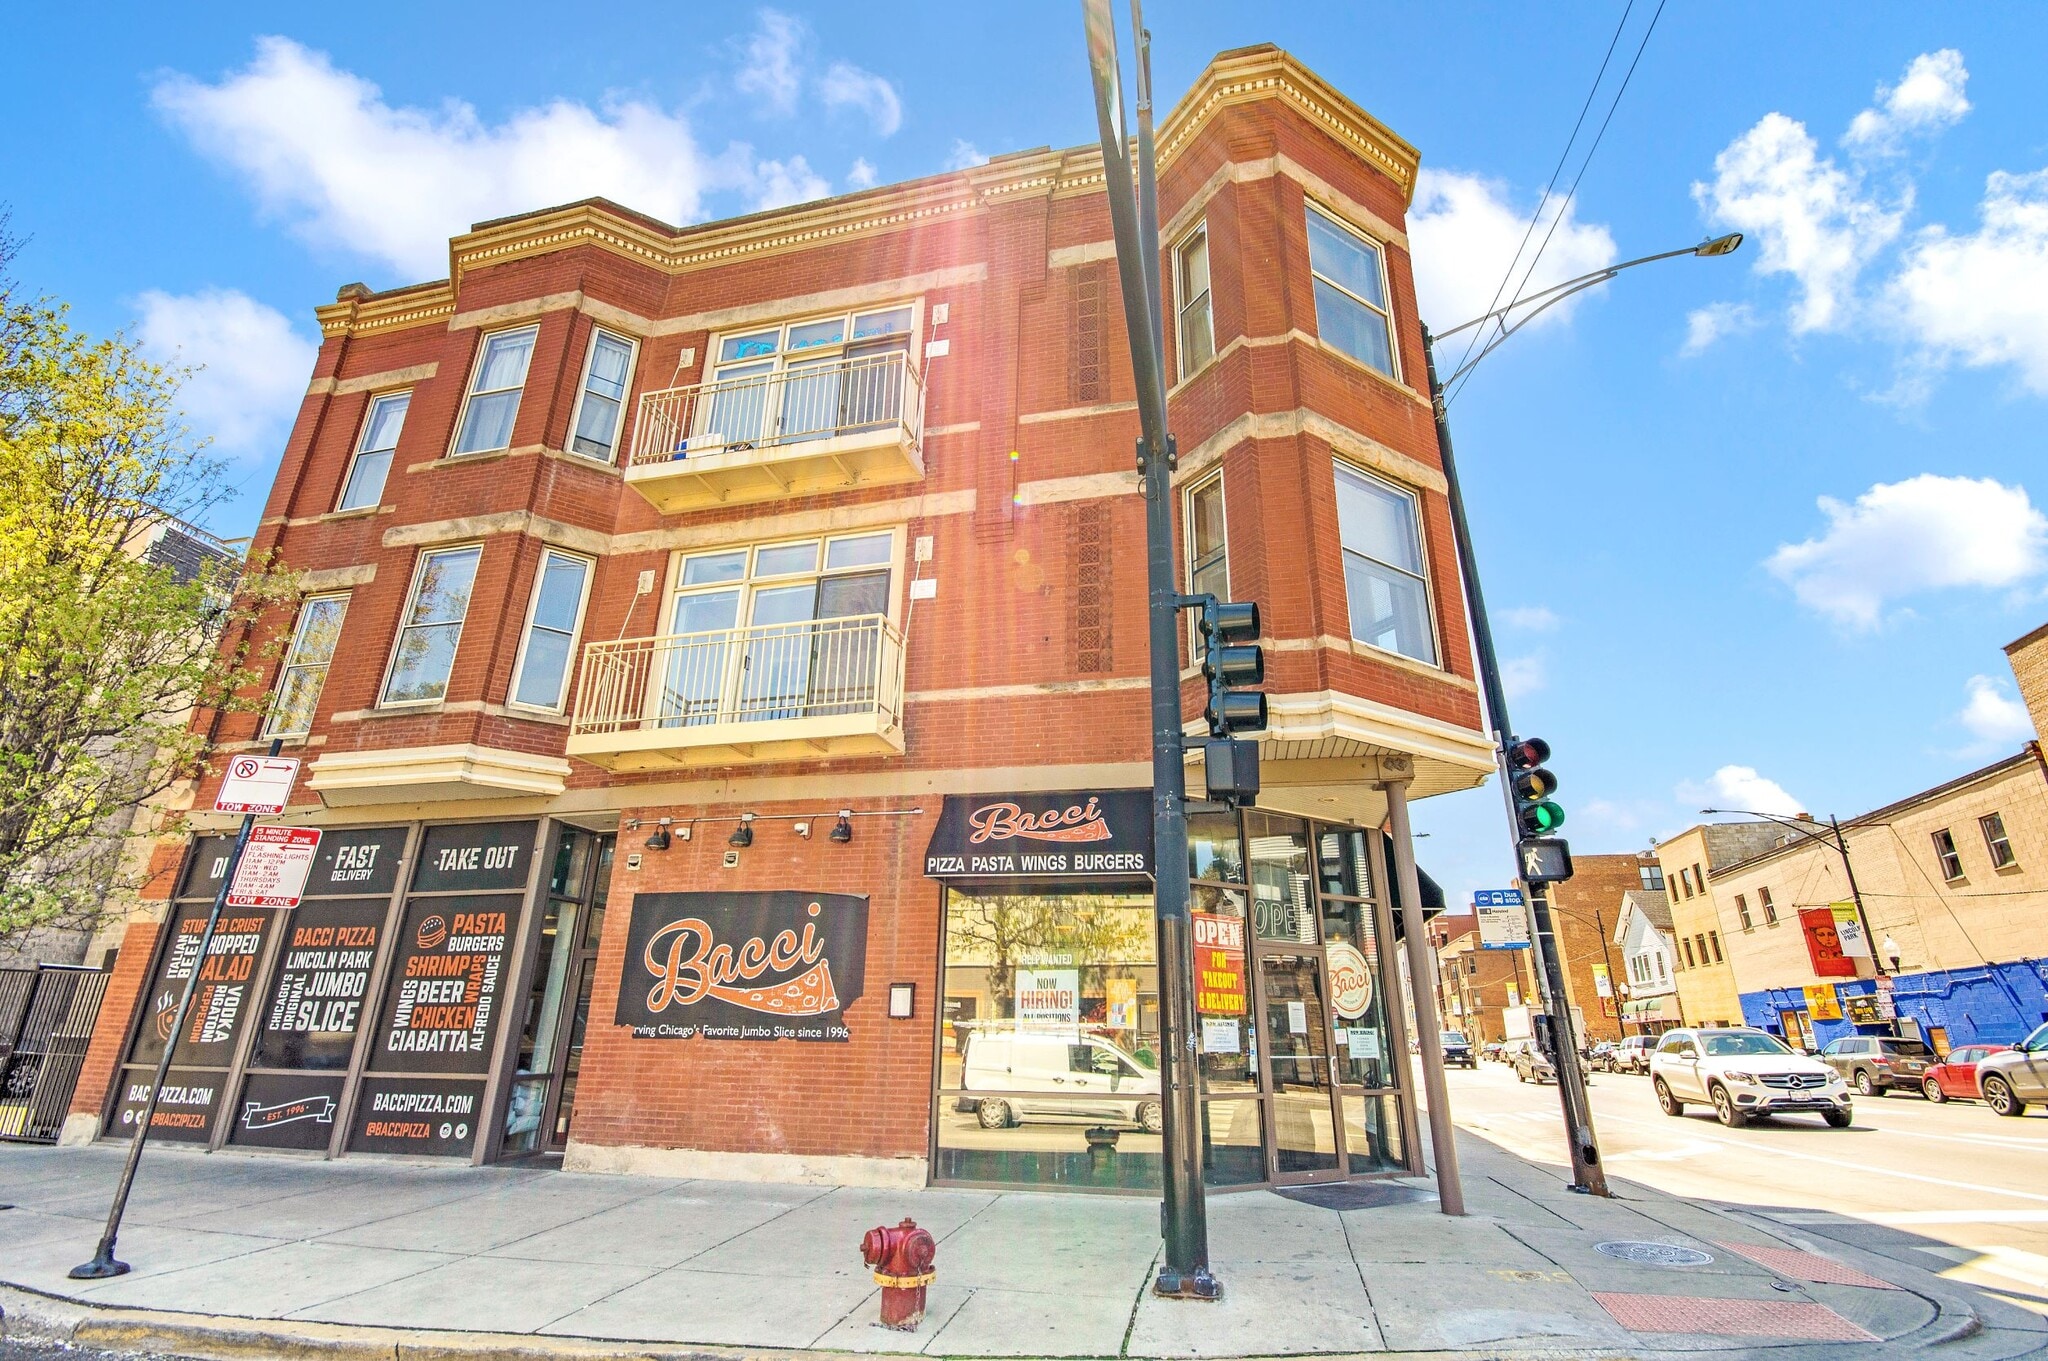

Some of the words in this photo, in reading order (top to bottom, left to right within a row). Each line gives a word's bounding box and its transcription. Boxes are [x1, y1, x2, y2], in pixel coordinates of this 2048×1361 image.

[220, 802, 243, 811] TOW
[248, 805, 278, 813] ZONE
[968, 796, 1102, 844] Bacci
[254, 835, 290, 843] STANDING
[284, 853, 310, 861] LIGHTS
[334, 844, 380, 869] FAST
[438, 847, 482, 871] TAKE
[484, 845, 519, 869] OUT
[927, 857, 965, 872] PIZZA
[971, 855, 1014, 871] PASTA
[1021, 854, 1067, 870] WINGS
[1074, 853, 1144, 870] BURGERS
[331, 869, 374, 881] DELIVERY
[232, 896, 257, 905] TOW
[264, 897, 294, 906] ZONE
[181, 918, 228, 933] STUFED
[229, 917, 265, 932] CRUST
[451, 912, 506, 935] PASTA
[1254, 900, 1312, 937] OPE
[293, 927, 335, 946] BACCI
[335, 926, 376, 946] PIZZA
[1195, 920, 1241, 946] OPEN
[1840, 925, 1861, 936] LINCOLN
[1844, 933, 1859, 941] PARK
[206, 934, 260, 954] HOPPED
[447, 935, 505, 952] BURGERS
[166, 934, 189, 978] ITALIAN
[177, 934, 201, 978] BEEF
[286, 951, 338, 969] LINCOLN
[338, 950, 373, 968] PARK
[405, 954, 471, 977] SHRIMP
[644, 902, 825, 1013] Bacci
[1042, 953, 1072, 965] WANTED
[1211, 951, 1227, 969] FOR
[199, 955, 254, 980] ALAD
[304, 972, 367, 997] JUMBO
[463, 954, 487, 1004] WRAPS
[1036, 977, 1057, 989] NOW
[1202, 971, 1238, 989] TAKEOUT
[1328, 965, 1370, 999] Bacci
[269, 973, 294, 1031] CHICAGO'S
[281, 973, 307, 1031] ORIGINAL
[416, 980, 465, 1004] BEER
[469, 996, 492, 1051] ALFREDO
[482, 954, 501, 993] SAUCE
[1021, 990, 1073, 1009] HIRING!
[1199, 992, 1205, 1009] &
[1206, 992, 1244, 1011] DELIVERY
[189, 985, 215, 1043] PEPPERONI
[200, 985, 228, 1043] RIGATONI
[212, 985, 244, 1043] VODKA
[393, 979, 418, 1028] WINGS
[295, 1001, 360, 1032] SLICE
[410, 1006, 477, 1029] CHICKEN
[387, 1030, 468, 1052] CIABATTA
[632, 1025, 656, 1037] rving
[658, 1024, 700, 1037] Chicago's
[702, 1024, 739, 1036] Favorite
[740, 1026, 771, 1038] Jumbo
[774, 1025, 795, 1037] Slice
[797, 1027, 822, 1038] since
[825, 1027, 849, 1038] 1996
[128, 1084, 214, 1106] BACPIZZA.COM
[372, 1093, 473, 1114] BACCIPIZZA.COM
[266, 1110, 283, 1121] EST.
[286, 1104, 305, 1117] 1996
[365, 1122, 431, 1138] @BACCIPIZZA
